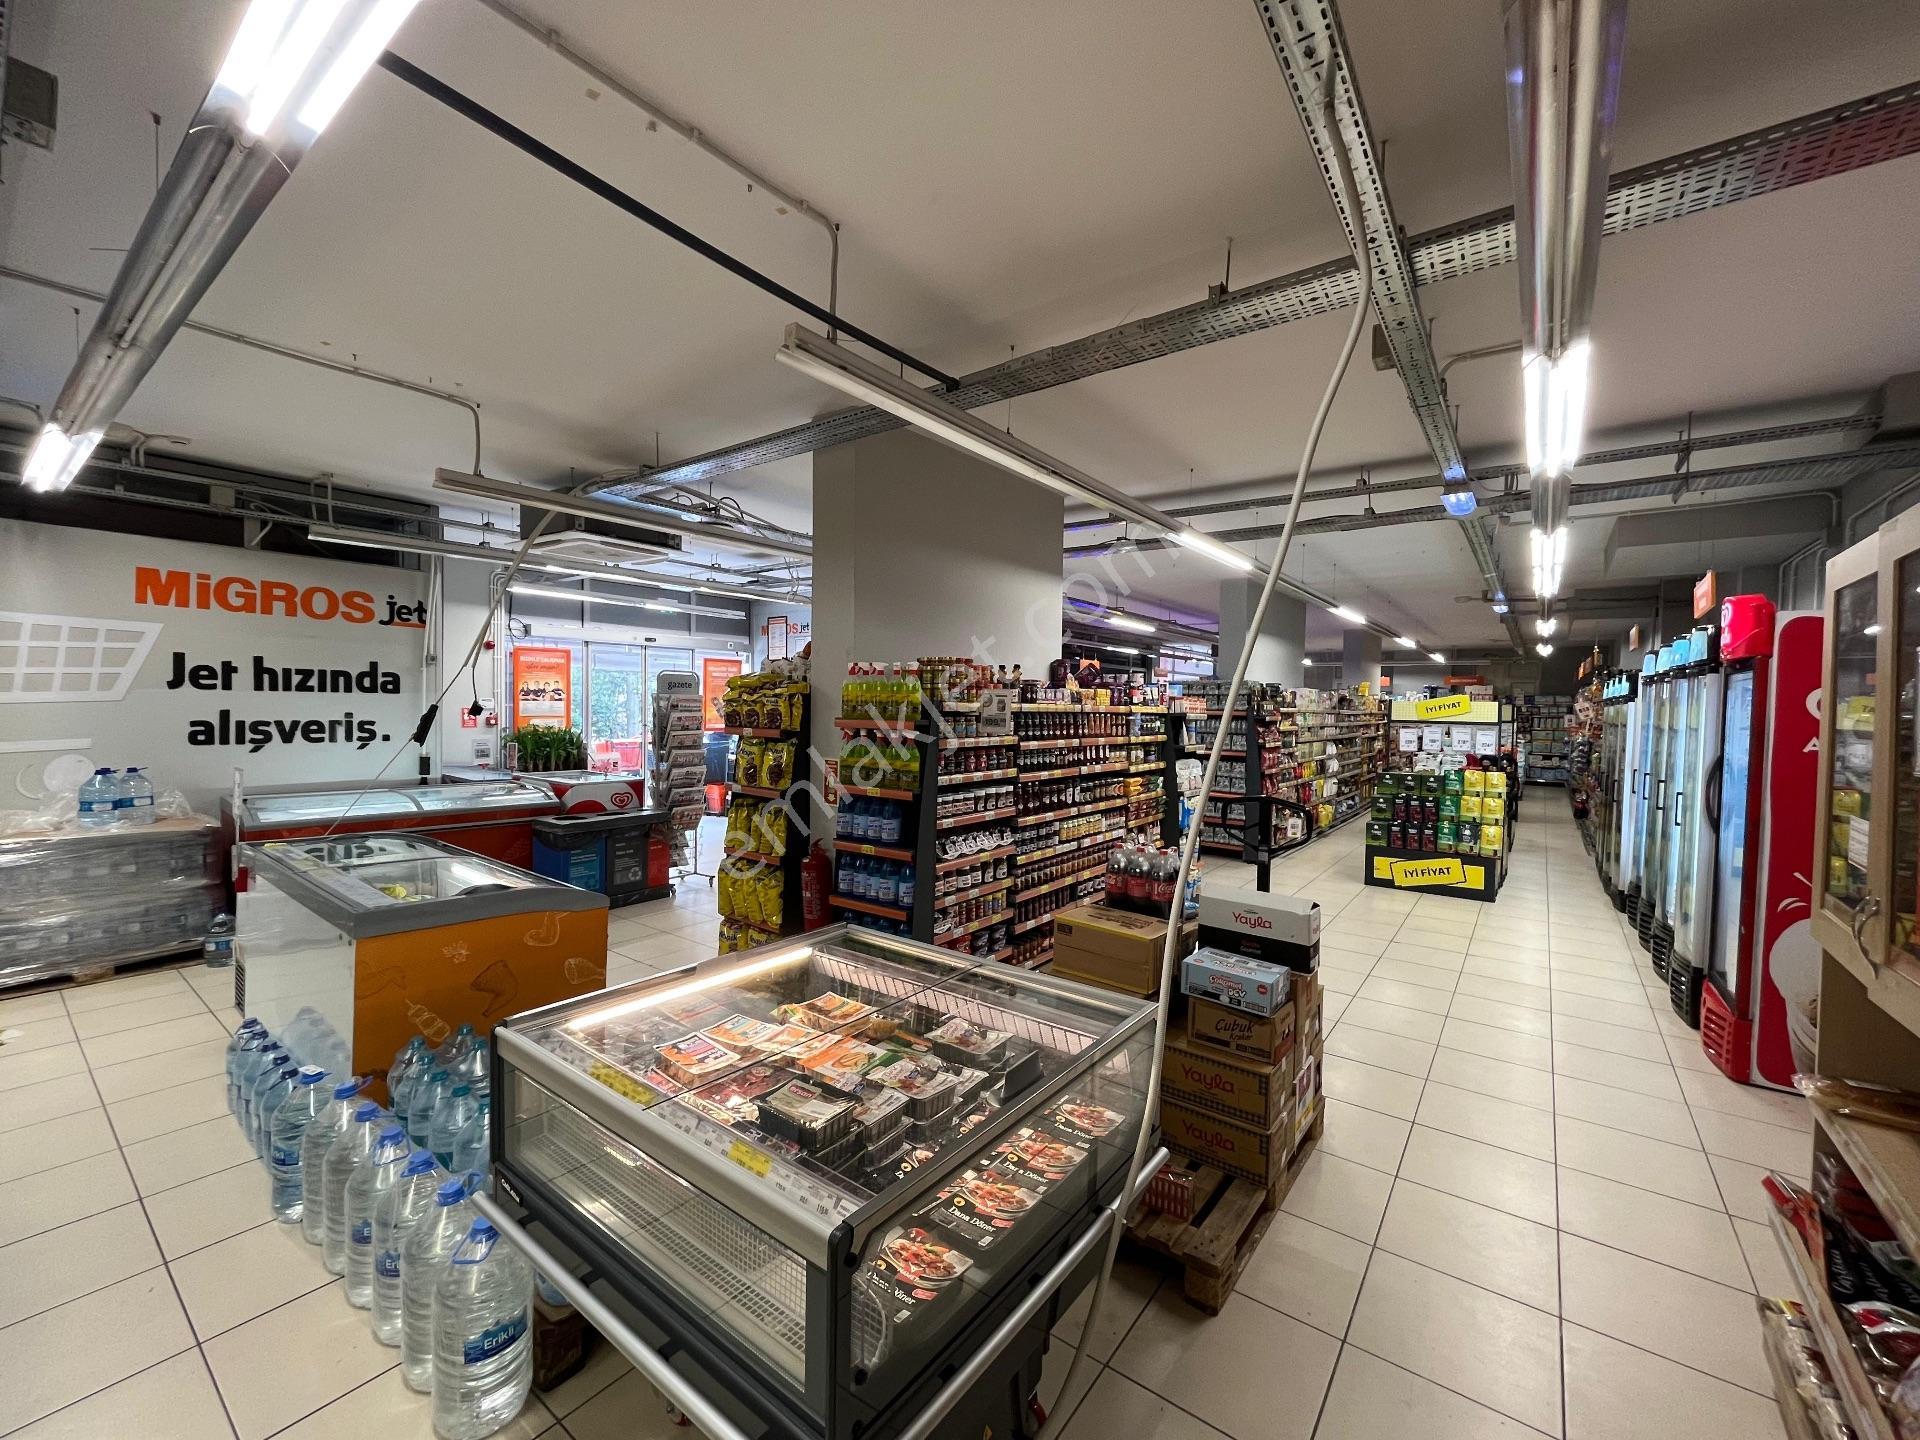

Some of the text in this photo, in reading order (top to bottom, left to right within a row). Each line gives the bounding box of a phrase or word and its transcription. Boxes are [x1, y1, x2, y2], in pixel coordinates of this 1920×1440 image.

[135, 567, 427, 625] MiGROS jet
[166, 652, 400, 694] Jet hızında
[667, 681, 692, 690] gazete
[188, 709, 390, 753] alışveriş.
[1404, 867, 1451, 878] İYİ FİYAT
[1232, 912, 1272, 929] Yayla
[1181, 1064, 1235, 1094] Yayla
[1181, 1120, 1236, 1152] Yayla
[948, 1206, 996, 1232] Dana Döner
[484, 1326, 514, 1349] Erikli
